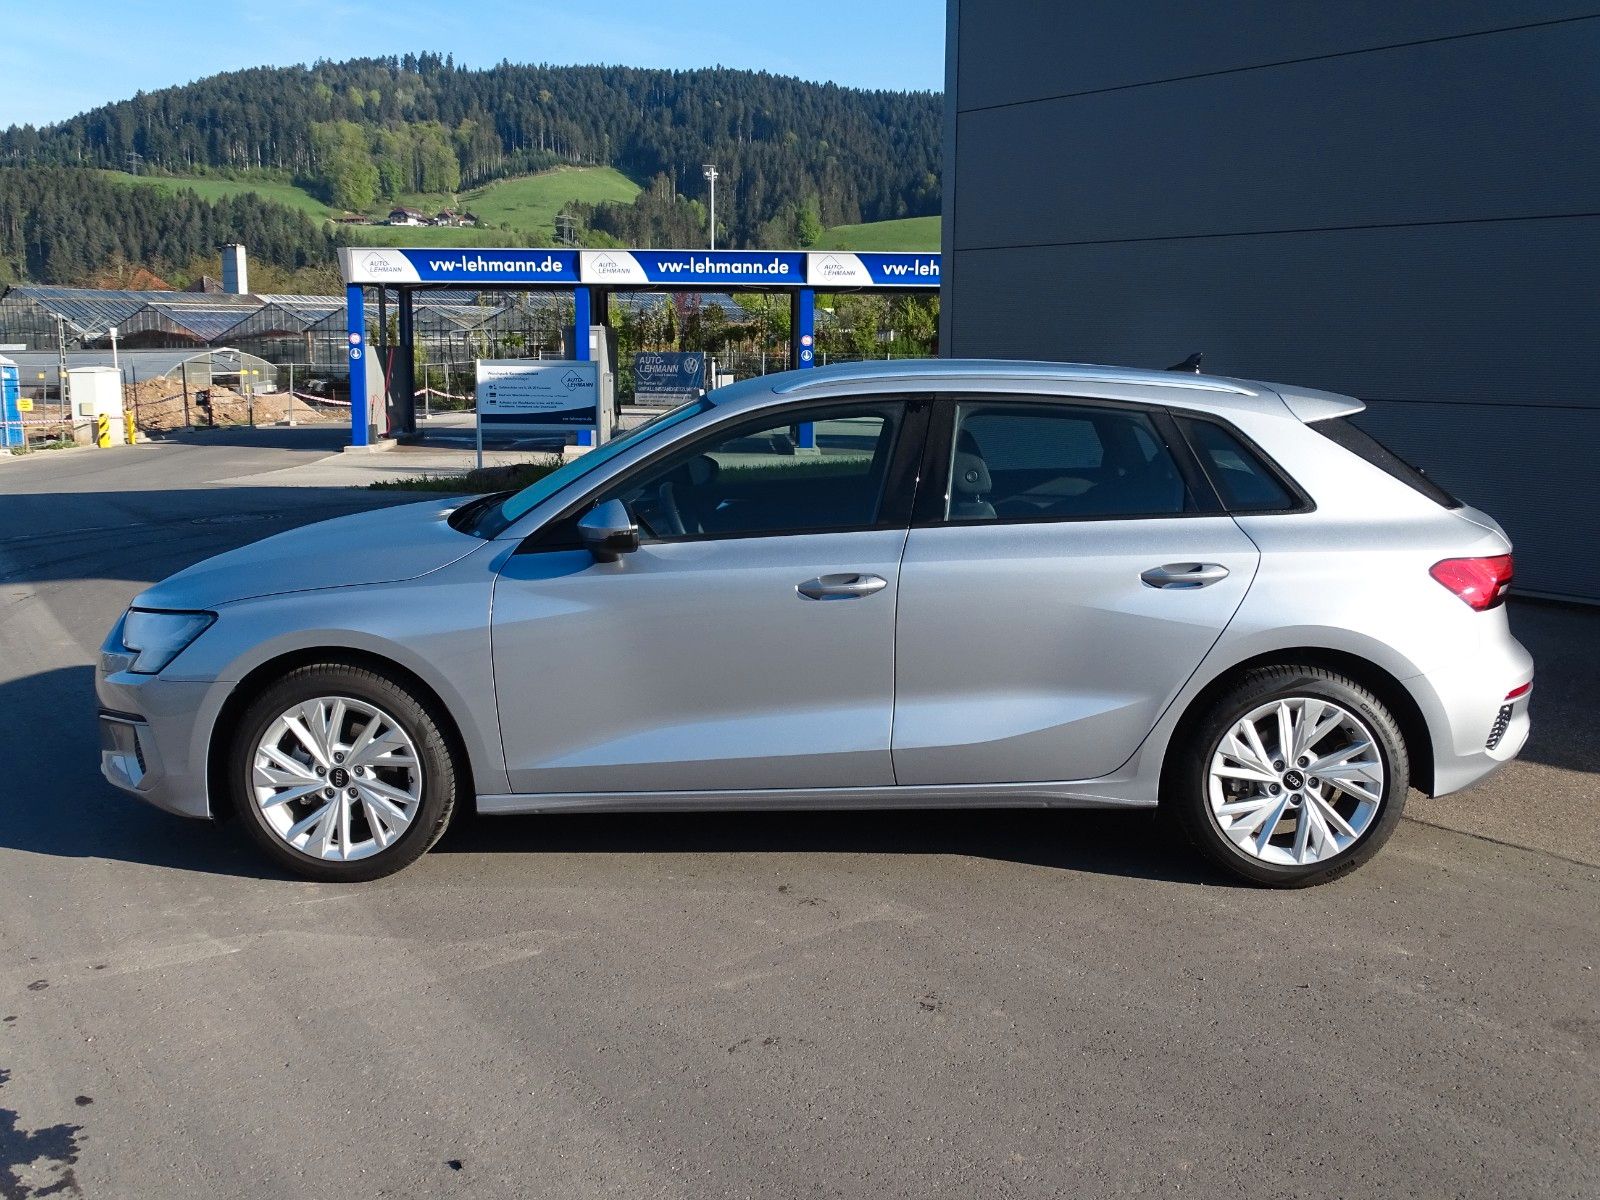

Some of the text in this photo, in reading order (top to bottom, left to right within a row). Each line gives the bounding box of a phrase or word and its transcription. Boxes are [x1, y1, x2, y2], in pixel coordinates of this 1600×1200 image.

[429, 255, 563, 272] vw-lehmann.de
[657, 256, 789, 274] vw-lehmann.de
[882, 259, 940, 276] vw-leh
[639, 356, 664, 364] AUTO-
[639, 364, 679, 373] LEHMANN
